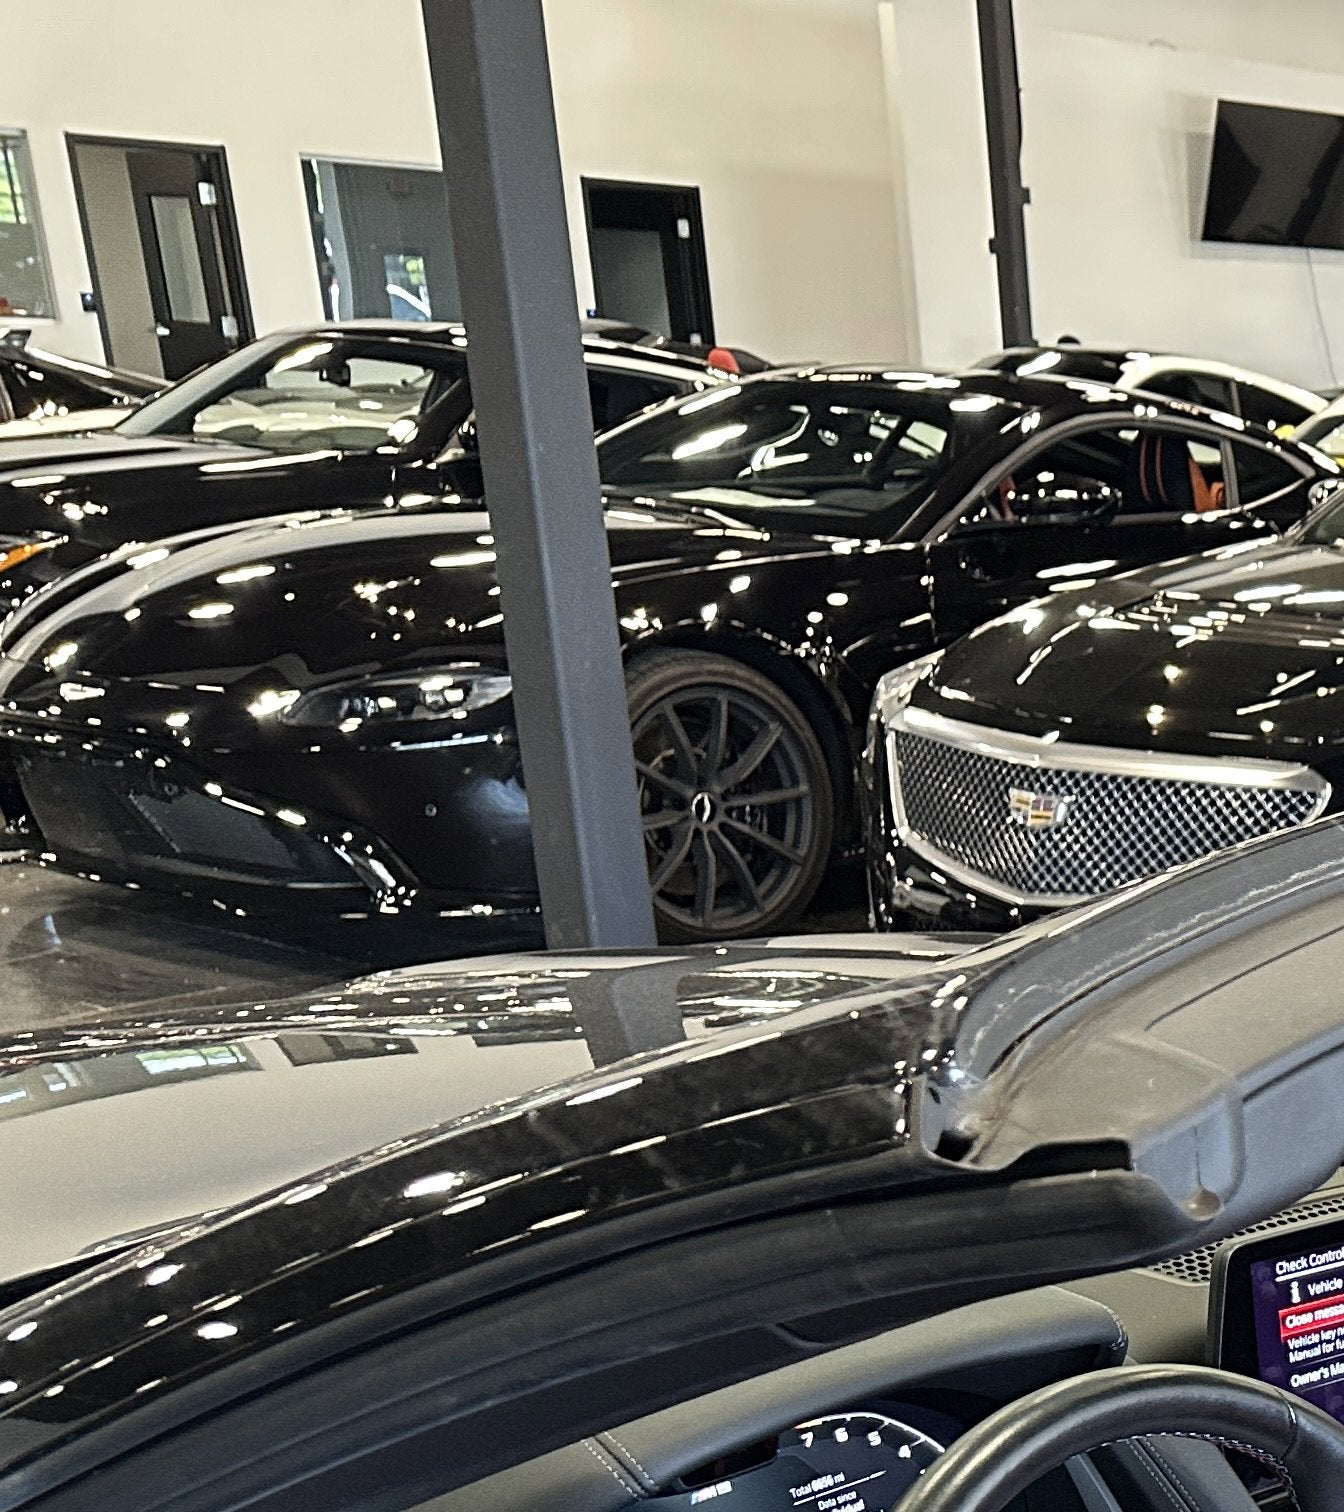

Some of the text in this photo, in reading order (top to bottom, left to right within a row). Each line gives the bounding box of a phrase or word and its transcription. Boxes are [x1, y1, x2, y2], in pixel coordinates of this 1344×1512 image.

[1275, 1256, 1308, 1275] Check
[1307, 1278, 1343, 1296] Vehicle
[1285, 1311, 1314, 1328] Close
[1287, 1333, 1320, 1350] Vehicle
[1320, 1327, 1337, 1341] key
[1288, 1344, 1322, 1364] Manual
[1321, 1339, 1335, 1354] for
[1290, 1366, 1330, 1388] Owner's
[800, 1427, 912, 1459] 7 6 5 4
[789, 1483, 812, 1499] Total
[818, 1490, 857, 1511] Data since
